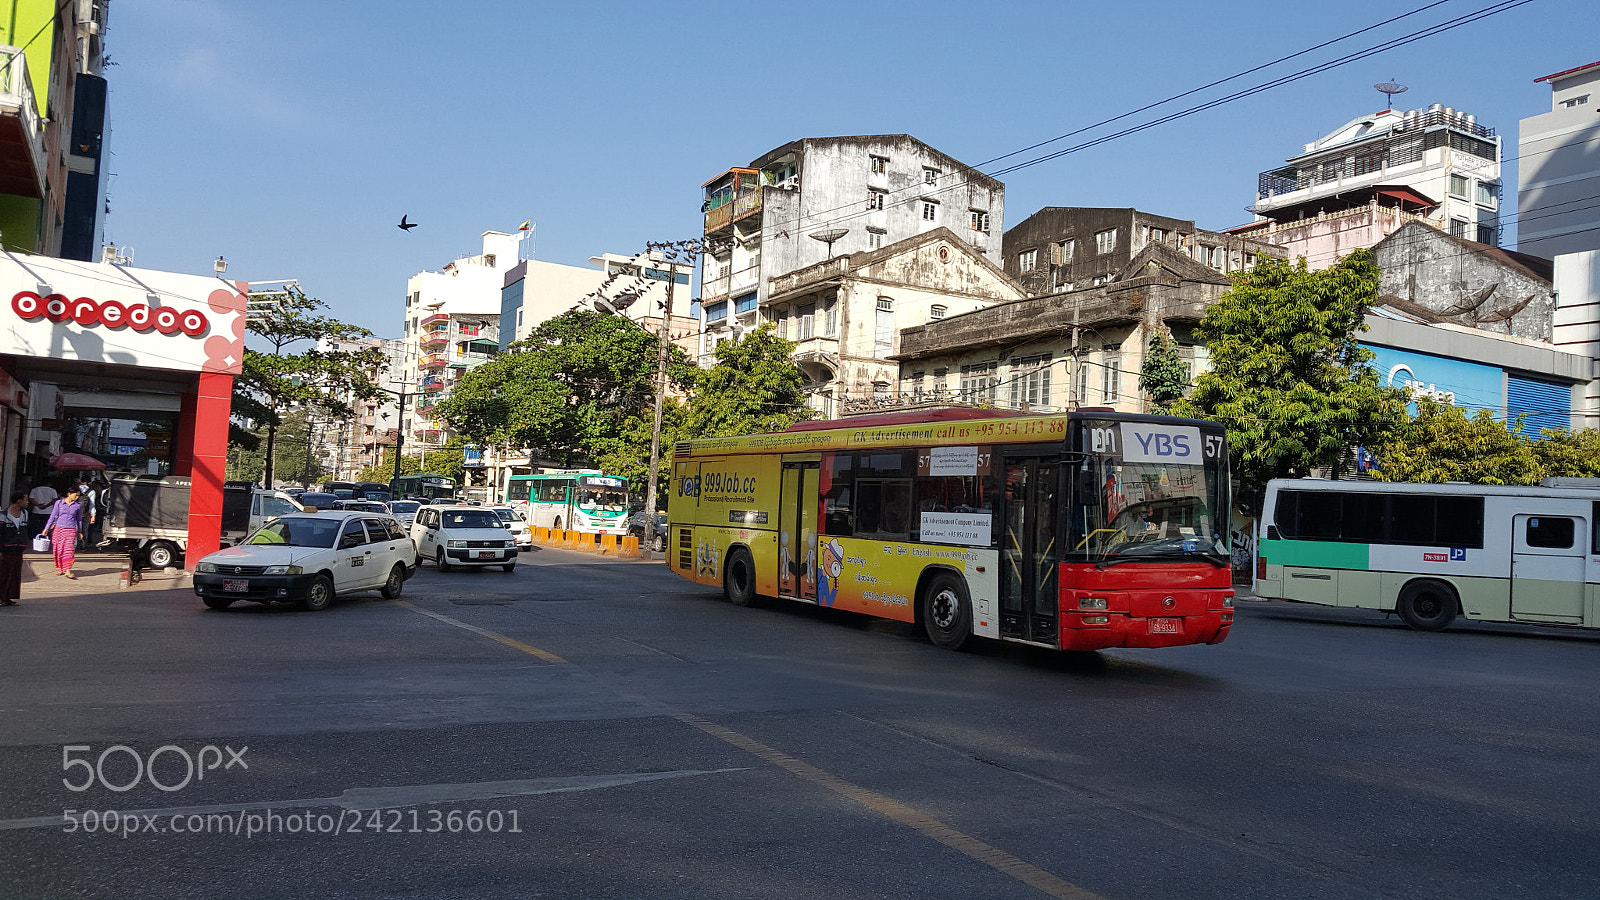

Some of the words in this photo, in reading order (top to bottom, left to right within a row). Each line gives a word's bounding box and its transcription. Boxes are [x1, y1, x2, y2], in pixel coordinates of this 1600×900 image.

[18, 297, 202, 330] ooredoo
[870, 428, 933, 442] Advertisement
[936, 426, 955, 438] call
[959, 427, 970, 437] us
[975, 423, 994, 436] +95
[999, 422, 1018, 435] 954
[1023, 420, 1044, 434] 113
[1049, 420, 1064, 433] 88
[1134, 432, 1190, 457] YBS
[1205, 435, 1223, 458] 57
[919, 455, 930, 468] 57
[978, 454, 991, 467] 57
[704, 472, 756, 493] 999Job.cc
[912, 546, 932, 558] English
